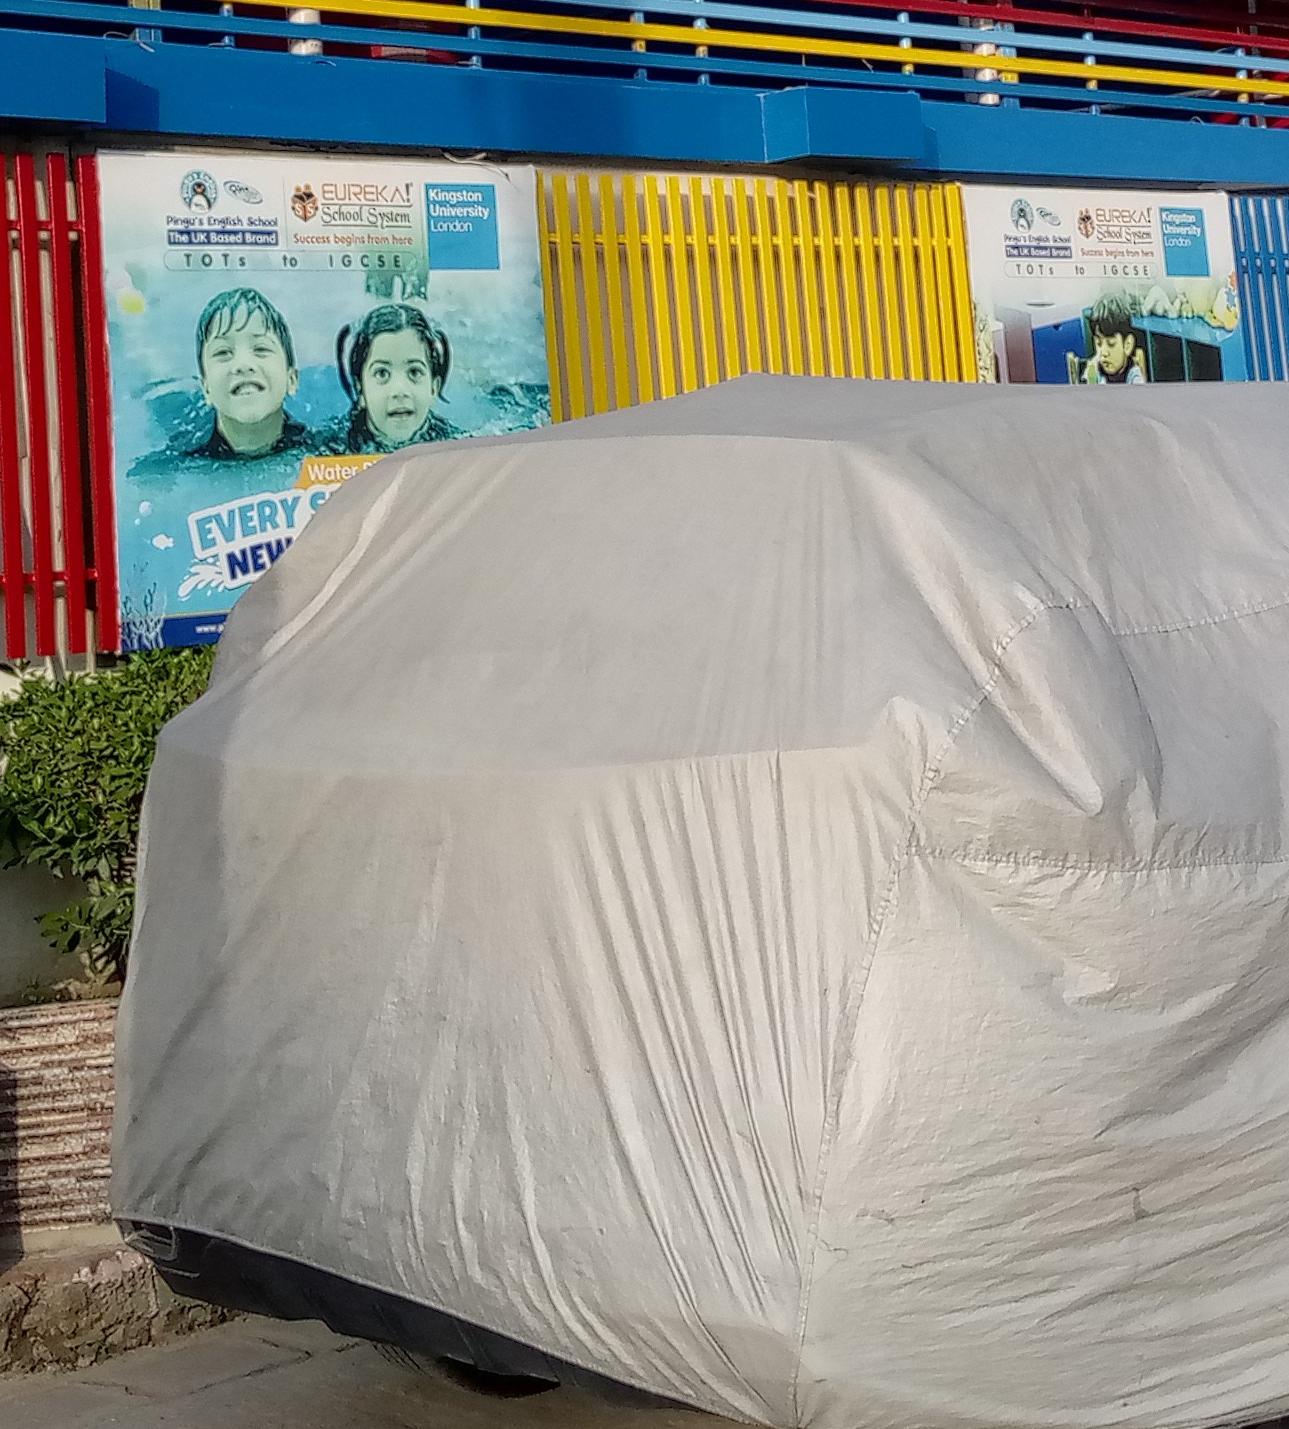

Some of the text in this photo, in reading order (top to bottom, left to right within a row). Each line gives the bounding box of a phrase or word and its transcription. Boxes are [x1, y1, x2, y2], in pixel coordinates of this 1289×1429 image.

[429, 189, 482, 203] Kingston
[320, 205, 411, 229] School System
[429, 204, 490, 220] University
[167, 215, 278, 228] Pingu's English School
[431, 219, 473, 232] London
[169, 232, 276, 244] The UK Based Brand
[293, 233, 413, 247] Success begins from here
[282, 255, 298, 268] to
[308, 462, 358, 481] Water
[195, 496, 302, 552] EVERY
